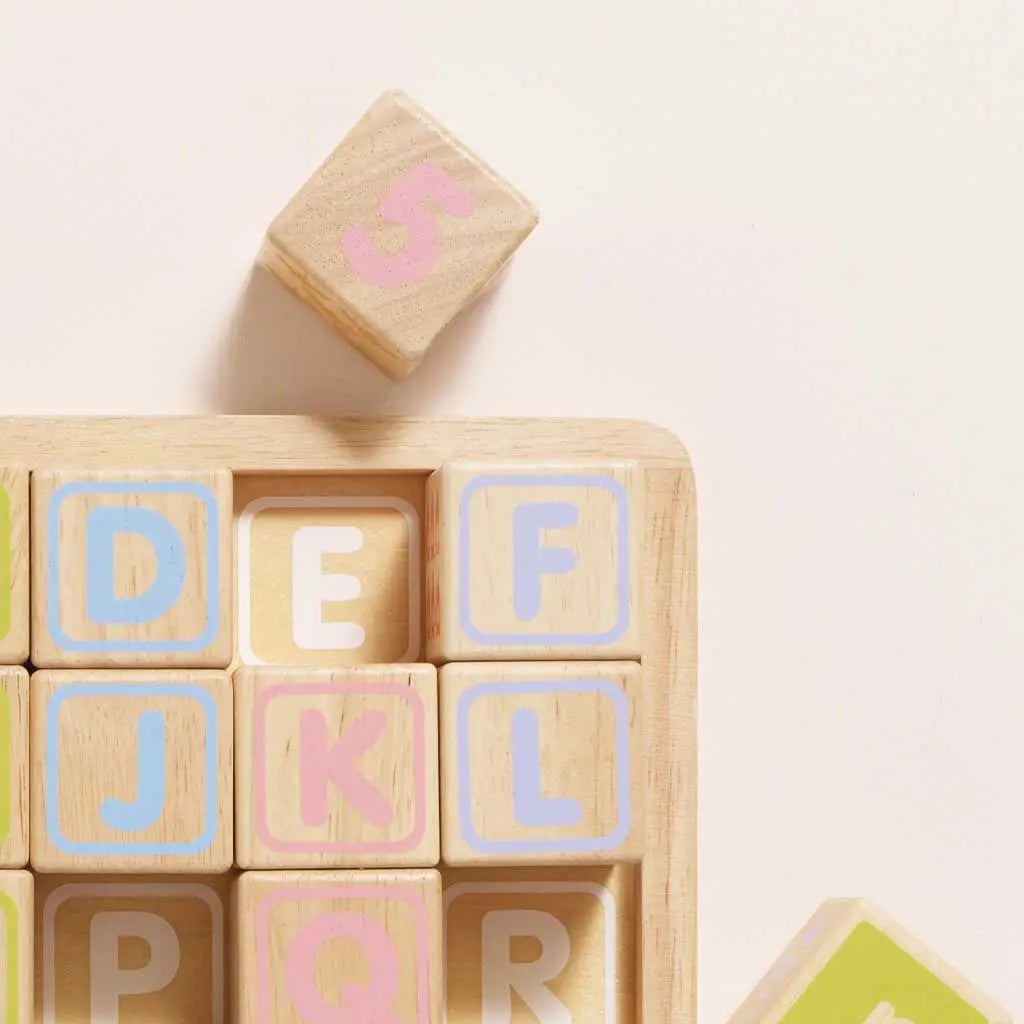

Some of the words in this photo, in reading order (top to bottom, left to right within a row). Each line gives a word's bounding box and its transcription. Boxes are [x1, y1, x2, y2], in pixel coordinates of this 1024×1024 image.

[341, 161, 475, 290] 5
[86, 506, 186, 624] D
[292, 526, 365, 650] E
[513, 502, 579, 621] F
[100, 709, 165, 831] J
[299, 708, 394, 828] K
[512, 708, 581, 826] L
